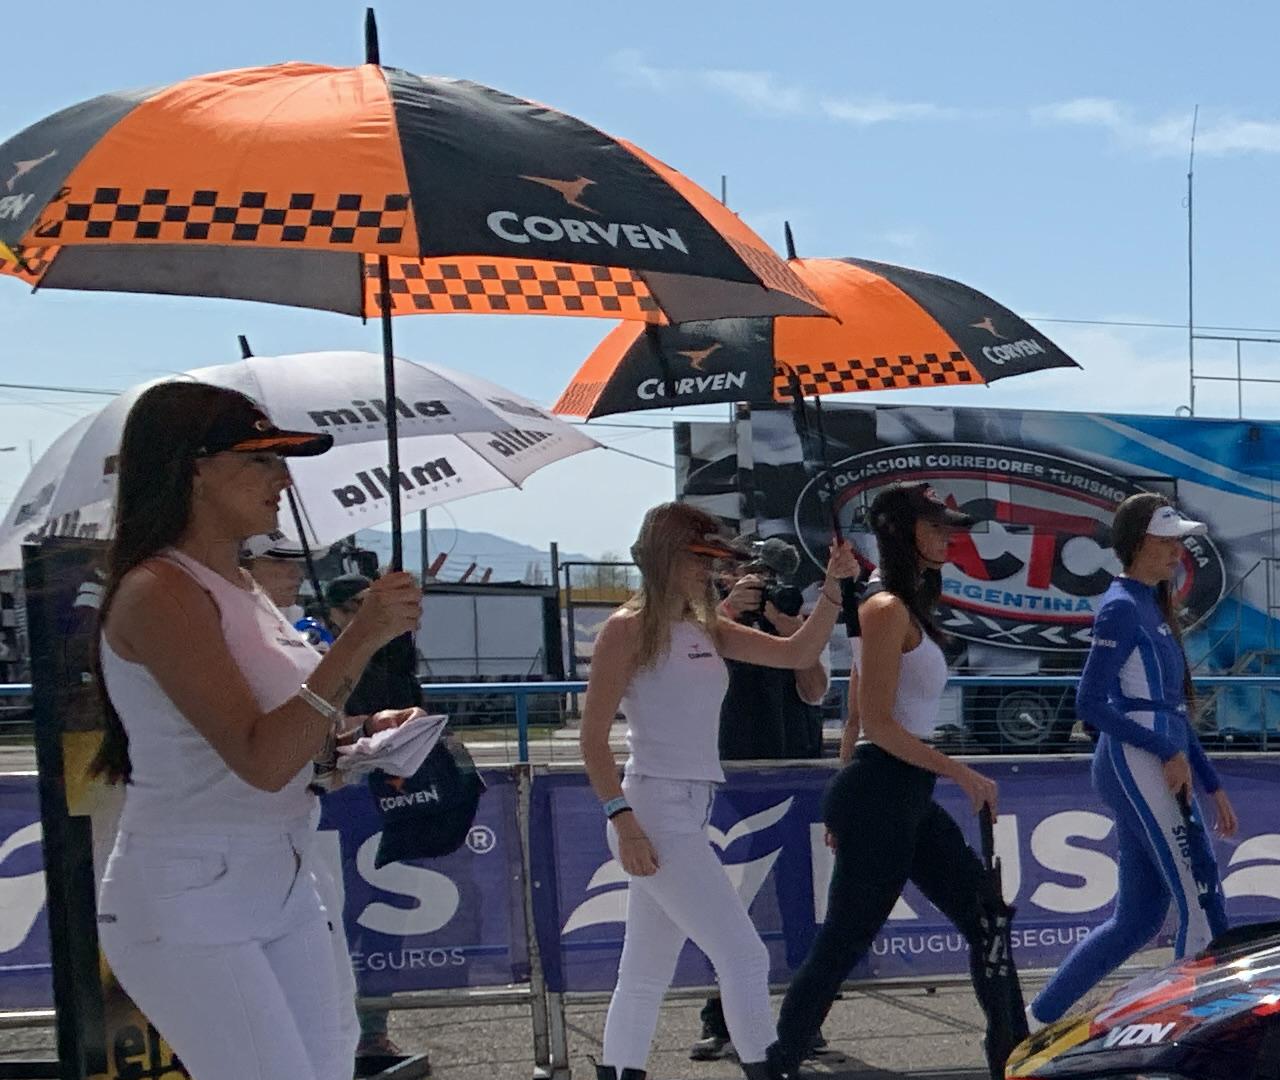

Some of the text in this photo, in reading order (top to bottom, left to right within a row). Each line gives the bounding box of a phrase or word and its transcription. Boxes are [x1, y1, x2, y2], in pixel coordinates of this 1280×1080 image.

[487, 210, 689, 255] CORVEN
[982, 338, 1046, 365] CORVEN
[925, 455, 1044, 477] CORREDORES
[943, 576, 1094, 612] RGENTINA
[380, 786, 439, 811] CORVEN
[350, 948, 467, 973] EGUROS
[1103, 1021, 1177, 1047] VDN
